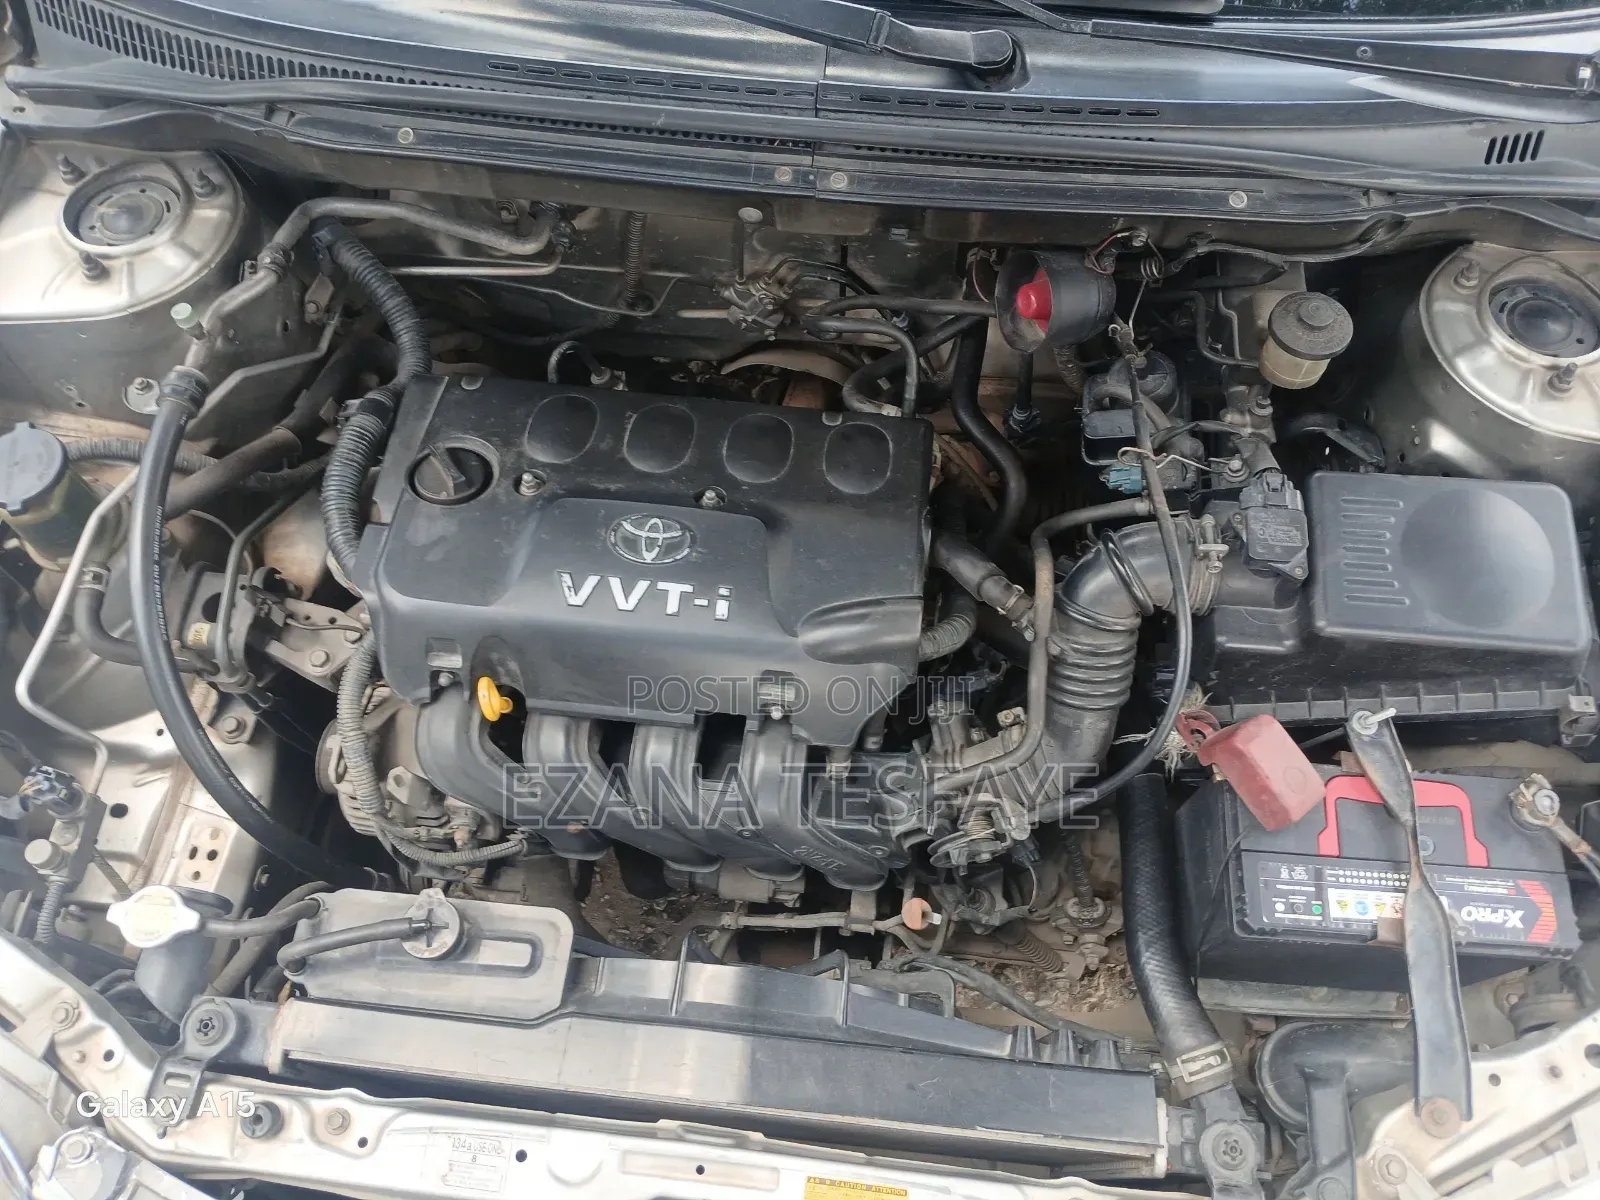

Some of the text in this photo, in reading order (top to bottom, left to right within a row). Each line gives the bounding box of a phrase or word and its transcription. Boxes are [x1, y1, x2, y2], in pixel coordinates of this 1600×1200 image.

[556, 570, 733, 622] VVT-i
[1460, 905, 1526, 929] X-PRO
[835, 1180, 867, 1191] CAUTION
[871, 1186, 908, 1197] ATTENTION
